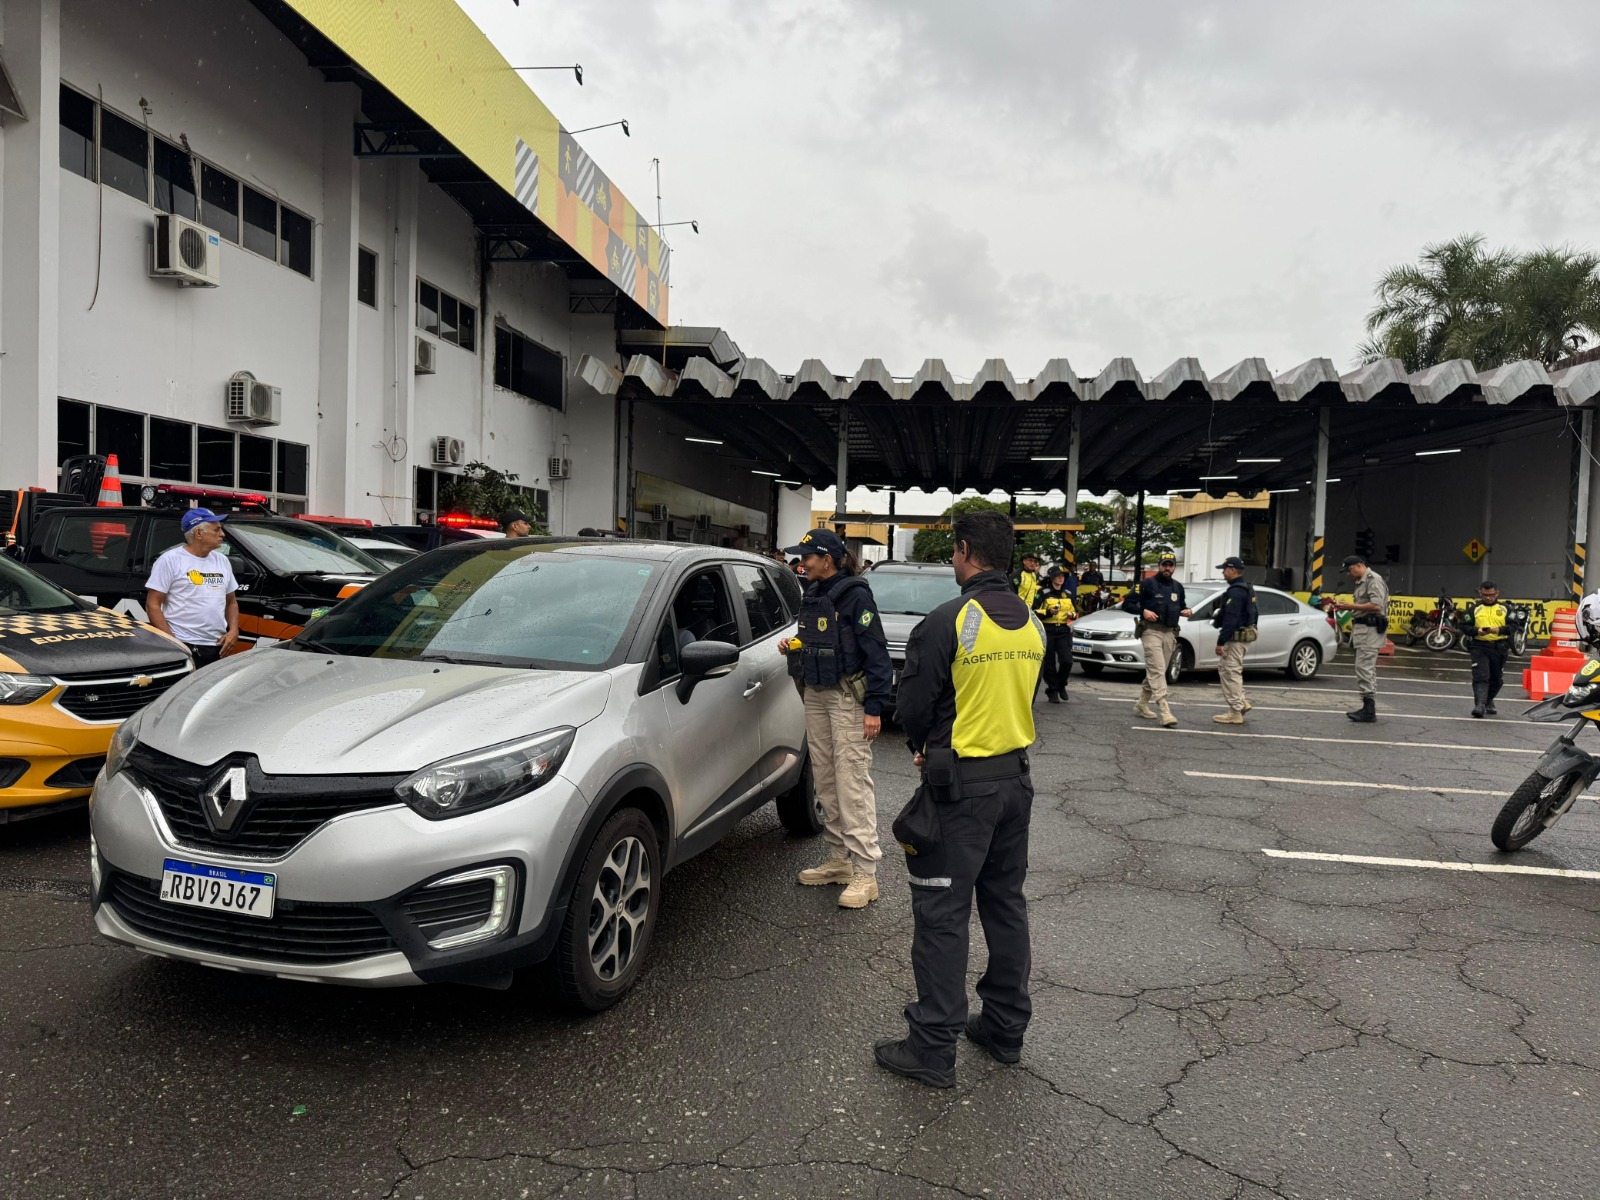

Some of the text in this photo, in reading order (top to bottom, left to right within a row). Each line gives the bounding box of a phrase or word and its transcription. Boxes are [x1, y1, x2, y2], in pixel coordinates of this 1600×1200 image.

[30, 630, 136, 645] EDUCAÇÃO
[962, 652, 1003, 665] AGENTE
[1005, 651, 1015, 660] DE
[208, 869, 227, 878] BRASIL
[161, 890, 169, 899] BR
[170, 874, 261, 911] RBV9J67
